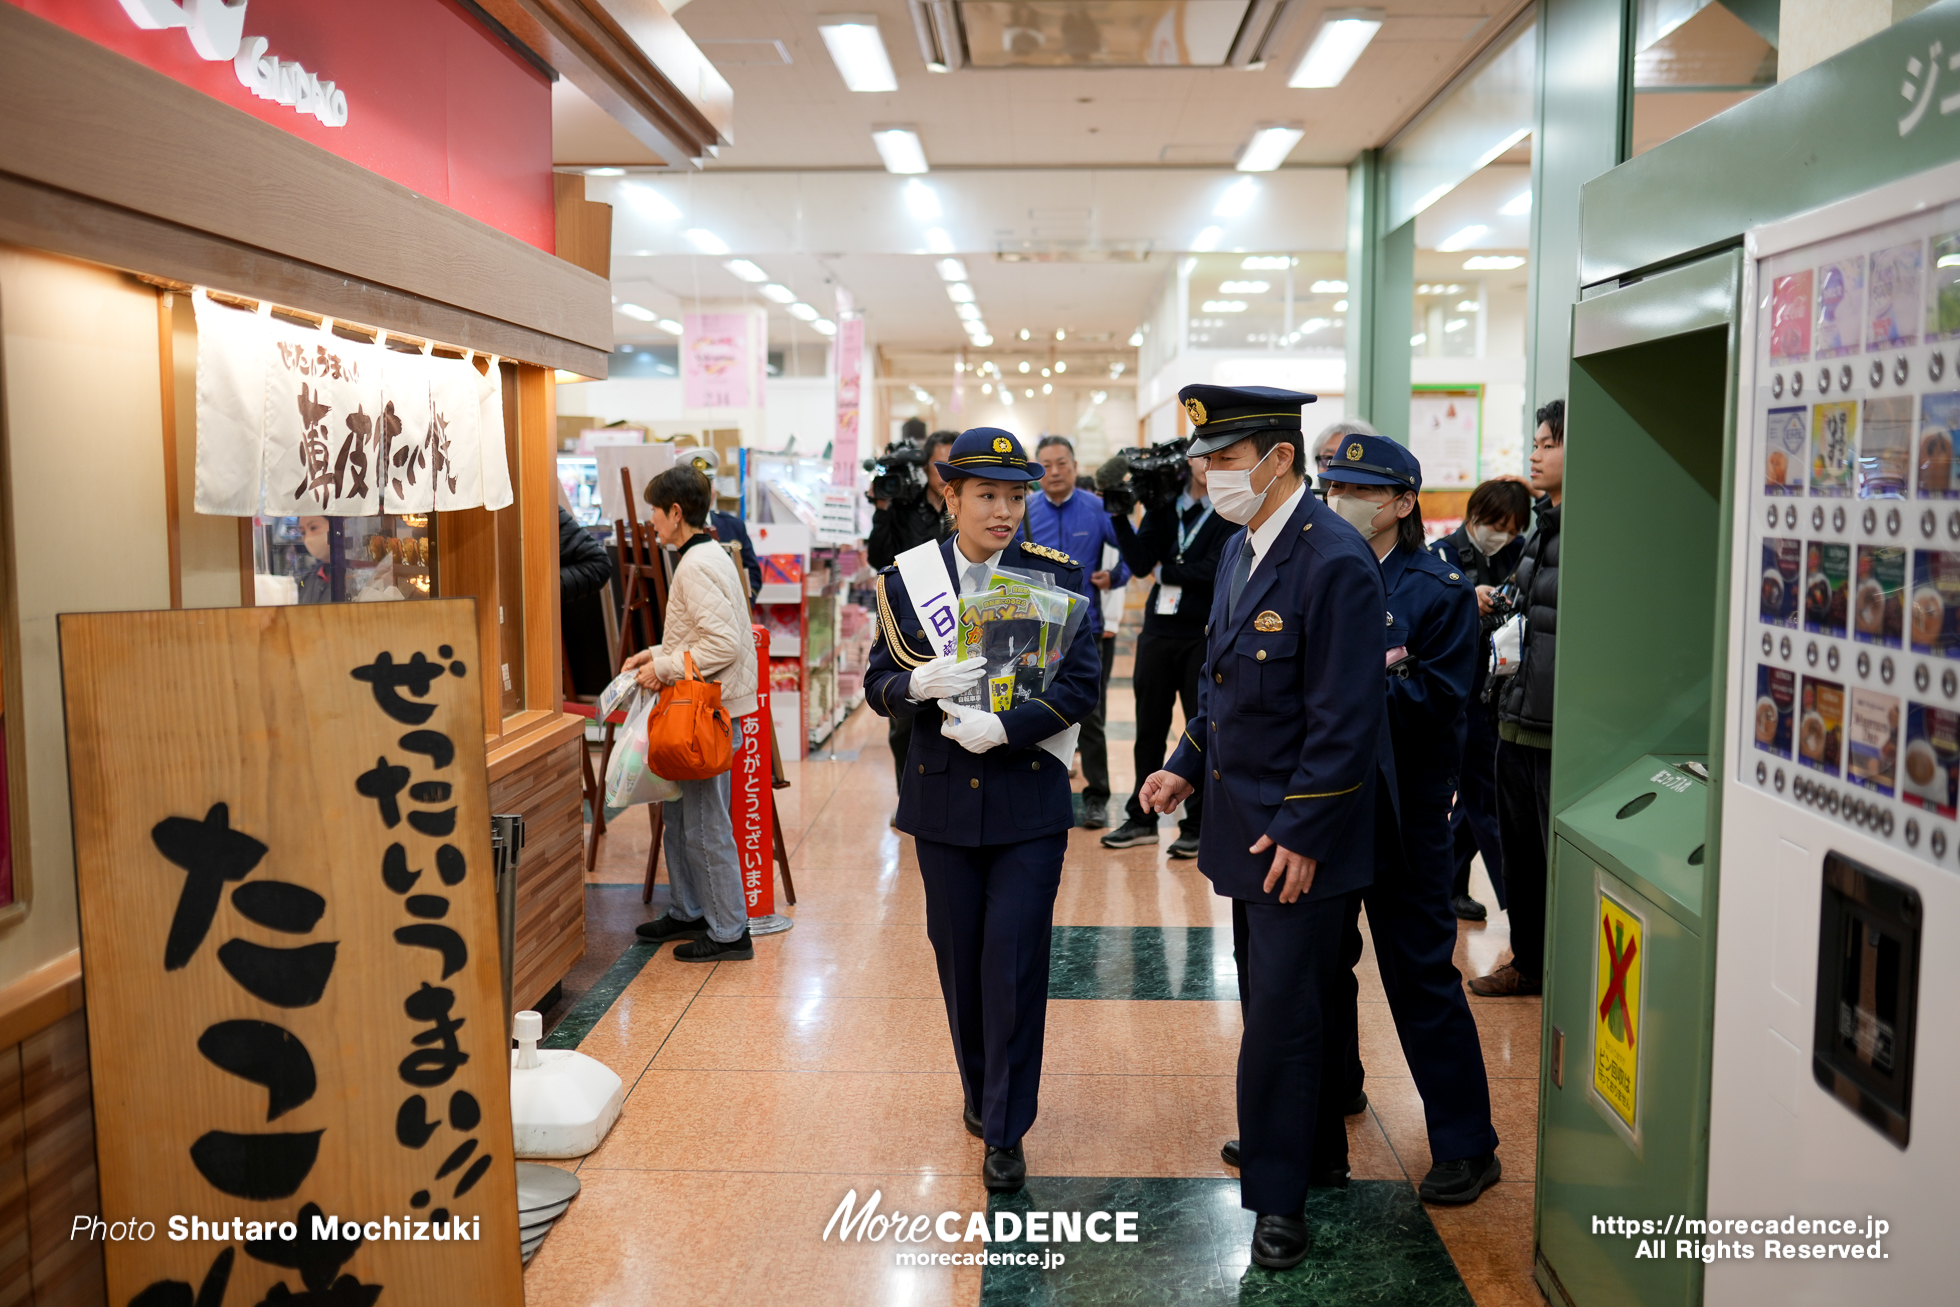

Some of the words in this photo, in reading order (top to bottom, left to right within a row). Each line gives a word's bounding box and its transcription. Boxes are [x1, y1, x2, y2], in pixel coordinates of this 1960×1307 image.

[743, 717, 762, 907] ありがとうございます
[1598, 1067, 1631, 1111] 行っておりません
[1599, 1048, 1631, 1094] ビン回収は
